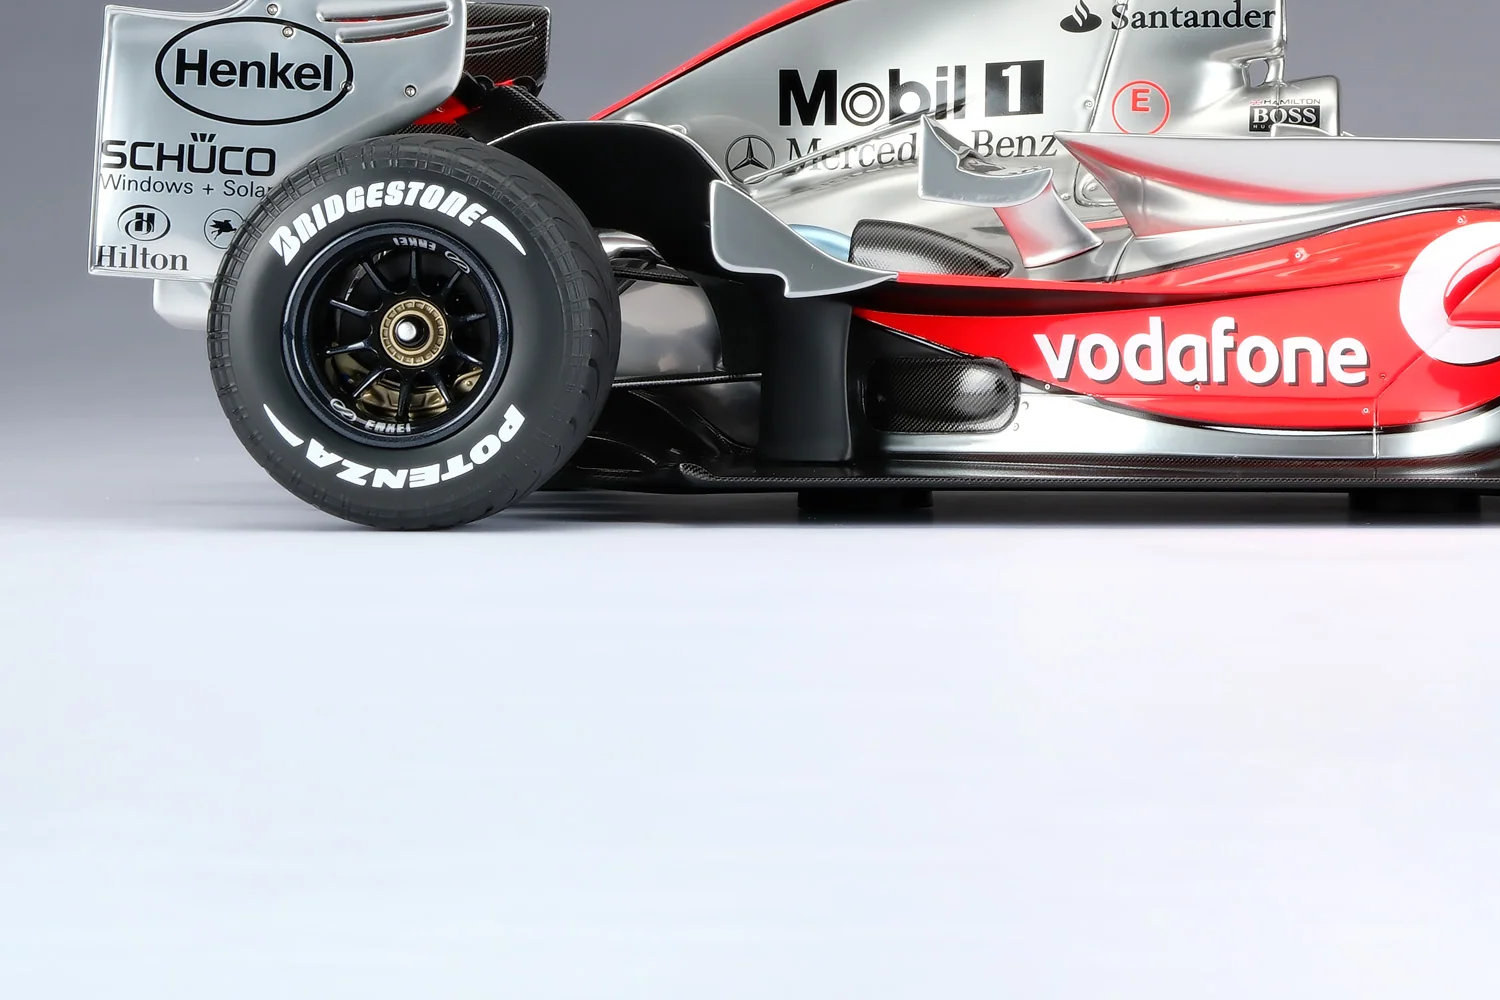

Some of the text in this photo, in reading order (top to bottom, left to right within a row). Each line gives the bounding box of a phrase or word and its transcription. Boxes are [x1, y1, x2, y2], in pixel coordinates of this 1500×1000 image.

[174, 47, 334, 91] Henkel
[778, 64, 967, 127] Mobil
[1130, 88, 1151, 113] E
[1252, 107, 1317, 124] BOSS
[101, 132, 277, 177] SCHÜCO
[100, 173, 194, 195] Windows
[268, 180, 487, 266] BRIDGESTONE
[97, 244, 190, 271] Hilton
[392, 237, 437, 252] ENKEI
[1033, 315, 1371, 388] vodafone
[364, 419, 412, 434] ENKEI
[305, 403, 526, 489] POTENZA
